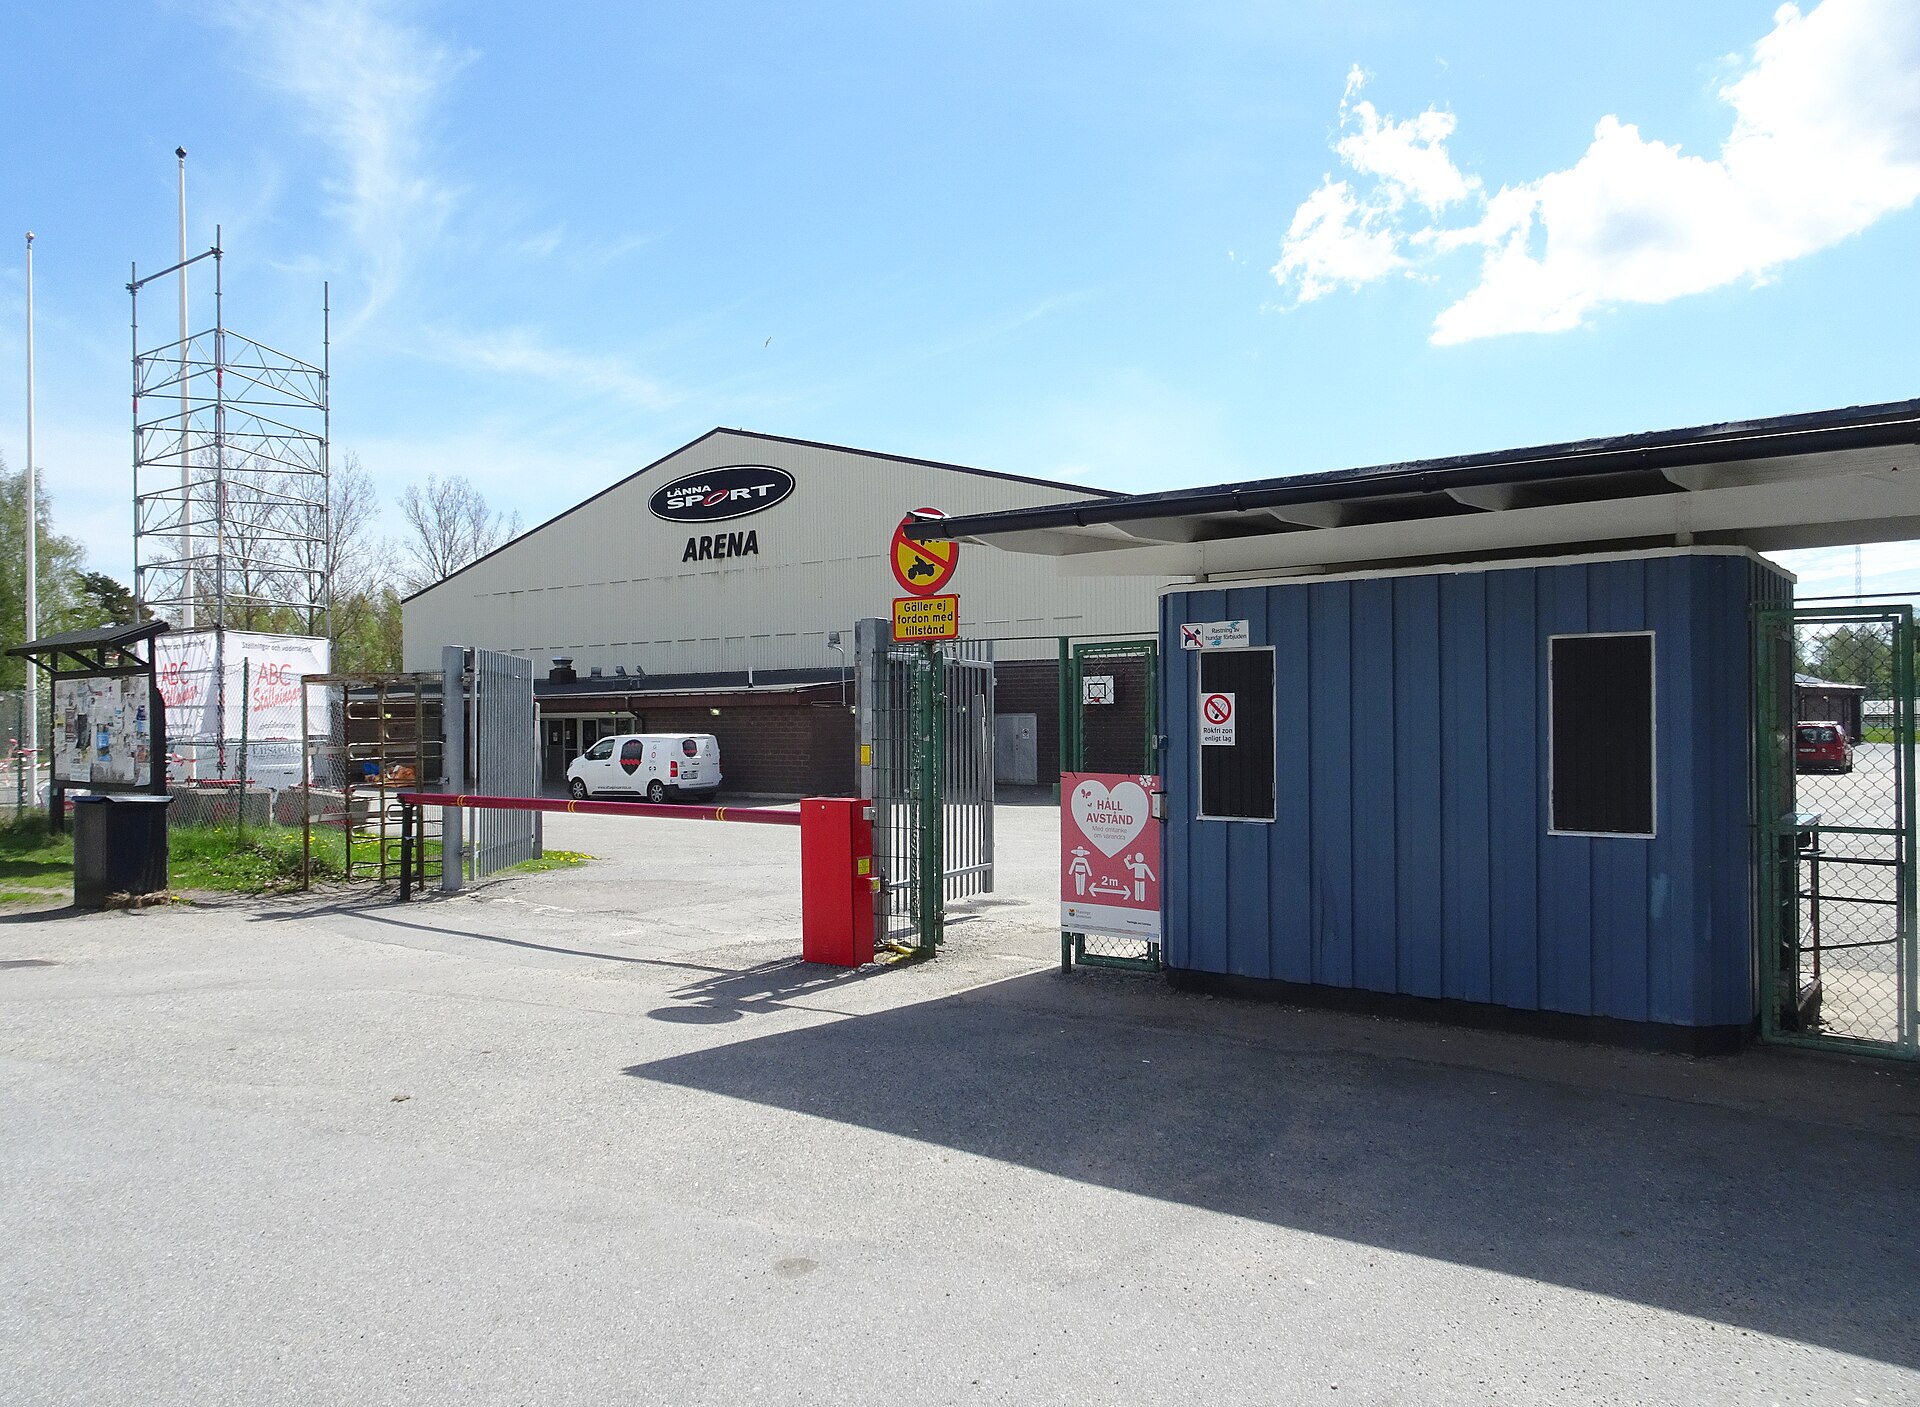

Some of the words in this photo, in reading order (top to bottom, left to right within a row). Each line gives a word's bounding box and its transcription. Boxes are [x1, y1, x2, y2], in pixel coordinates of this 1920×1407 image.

[667, 485, 712, 498] LÄNNA
[667, 484, 776, 509] SPORT
[682, 530, 759, 562] ARENA
[904, 602, 933, 612] Gäller
[937, 600, 946, 612] ej
[898, 614, 929, 624] fordon
[933, 611, 953, 622] med
[905, 624, 945, 635] tillstånd
[1223, 633, 1247, 641] förbjuden
[161, 661, 189, 685] ABC
[256, 662, 292, 686] ABC
[1097, 797, 1123, 811] HÅLL
[1086, 811, 1134, 825] AVSTÅND
[1105, 826, 1127, 834] omtanke
[1103, 833, 1126, 841] varandra
